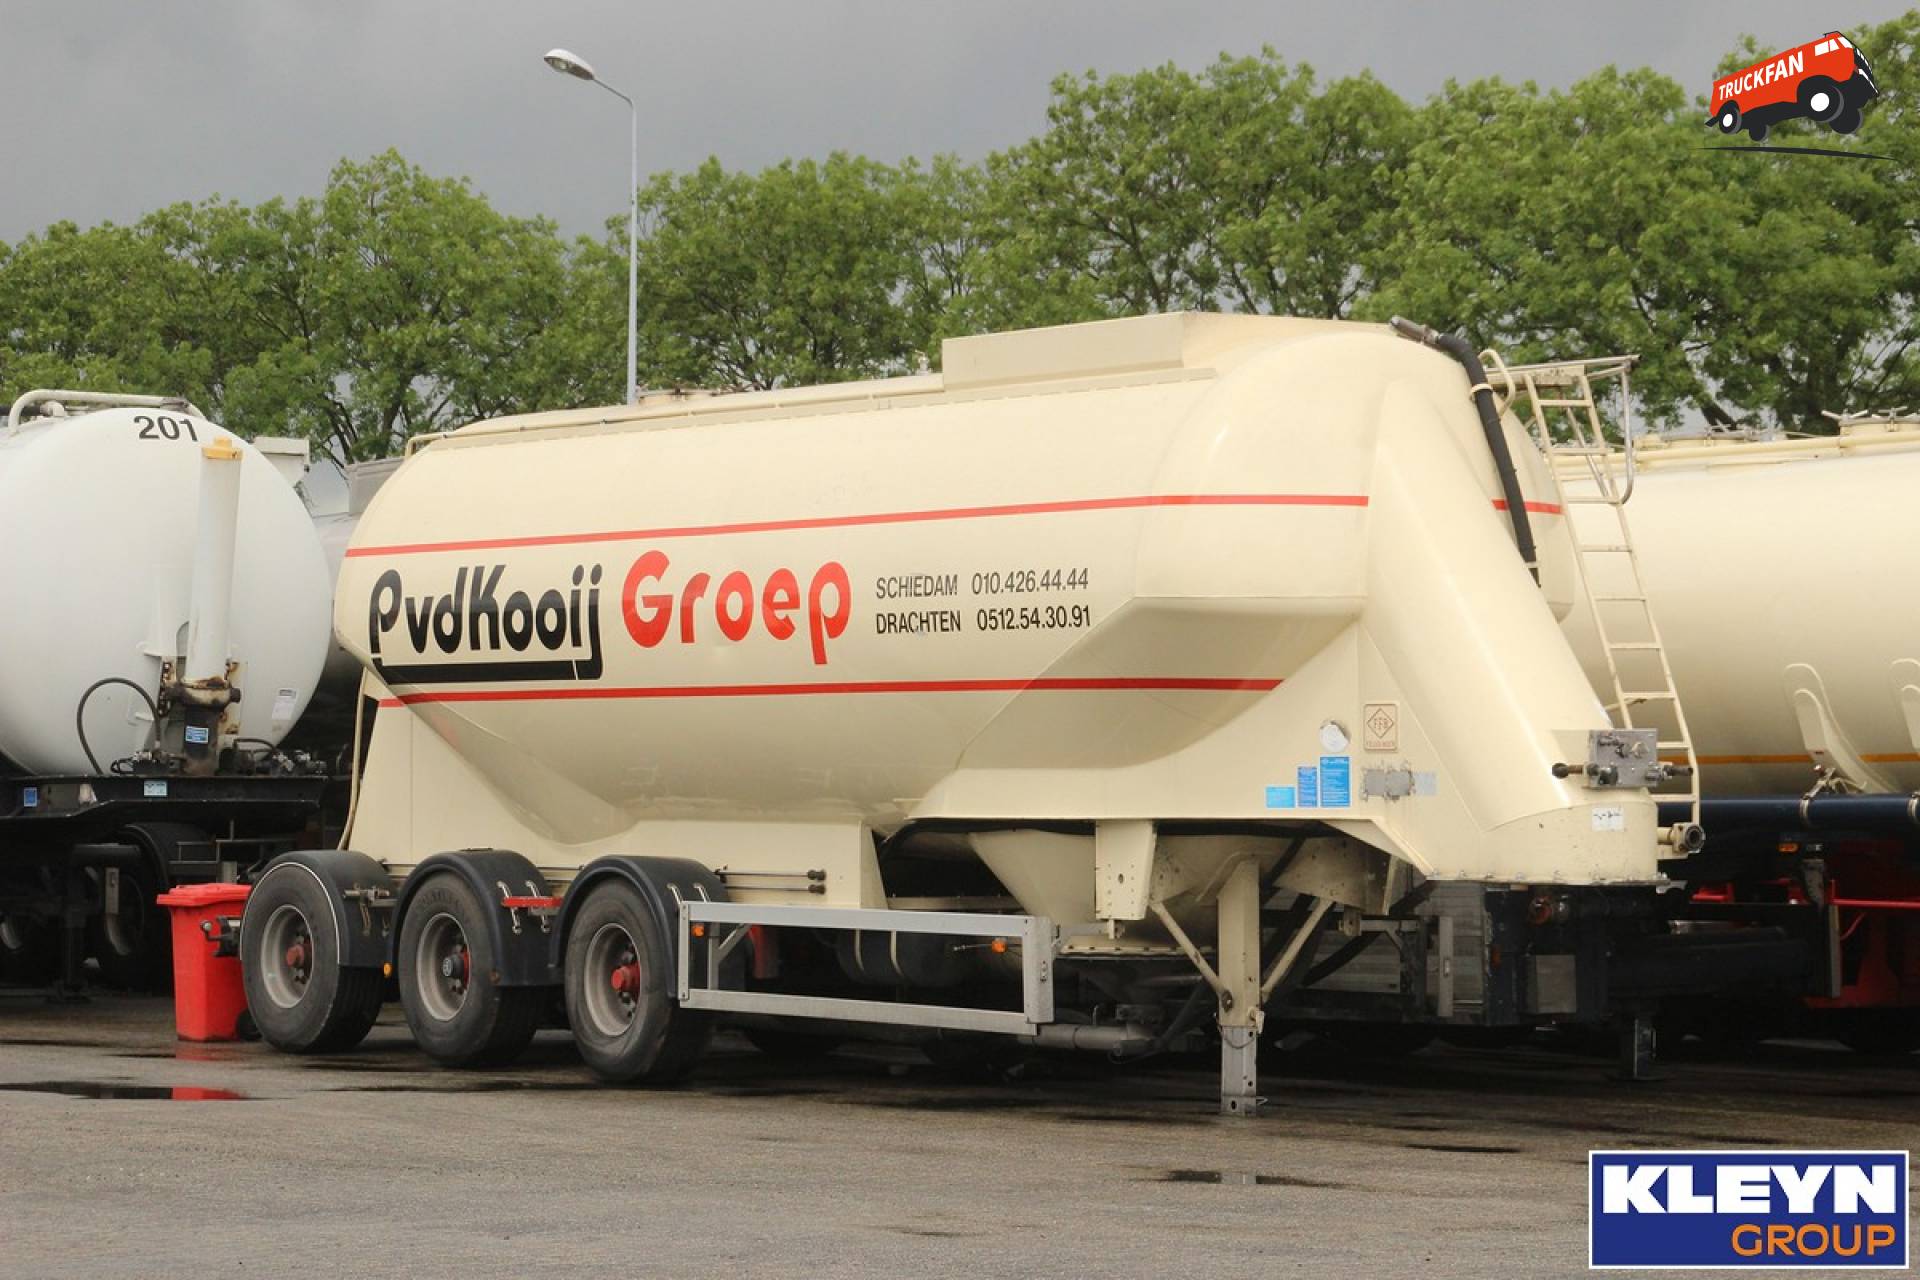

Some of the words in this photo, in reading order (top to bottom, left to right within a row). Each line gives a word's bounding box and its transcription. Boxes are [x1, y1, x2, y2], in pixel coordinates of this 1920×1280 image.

[133, 415, 198, 441] 201
[876, 574, 958, 599] SCHIEDAM
[971, 568, 1089, 595] 010.426.44.44
[369, 563, 604, 683] PvdKooij
[621, 550, 852, 665] Groep
[876, 610, 961, 634] DRACHTEN
[976, 605, 1091, 631] 0512.54.30.91
